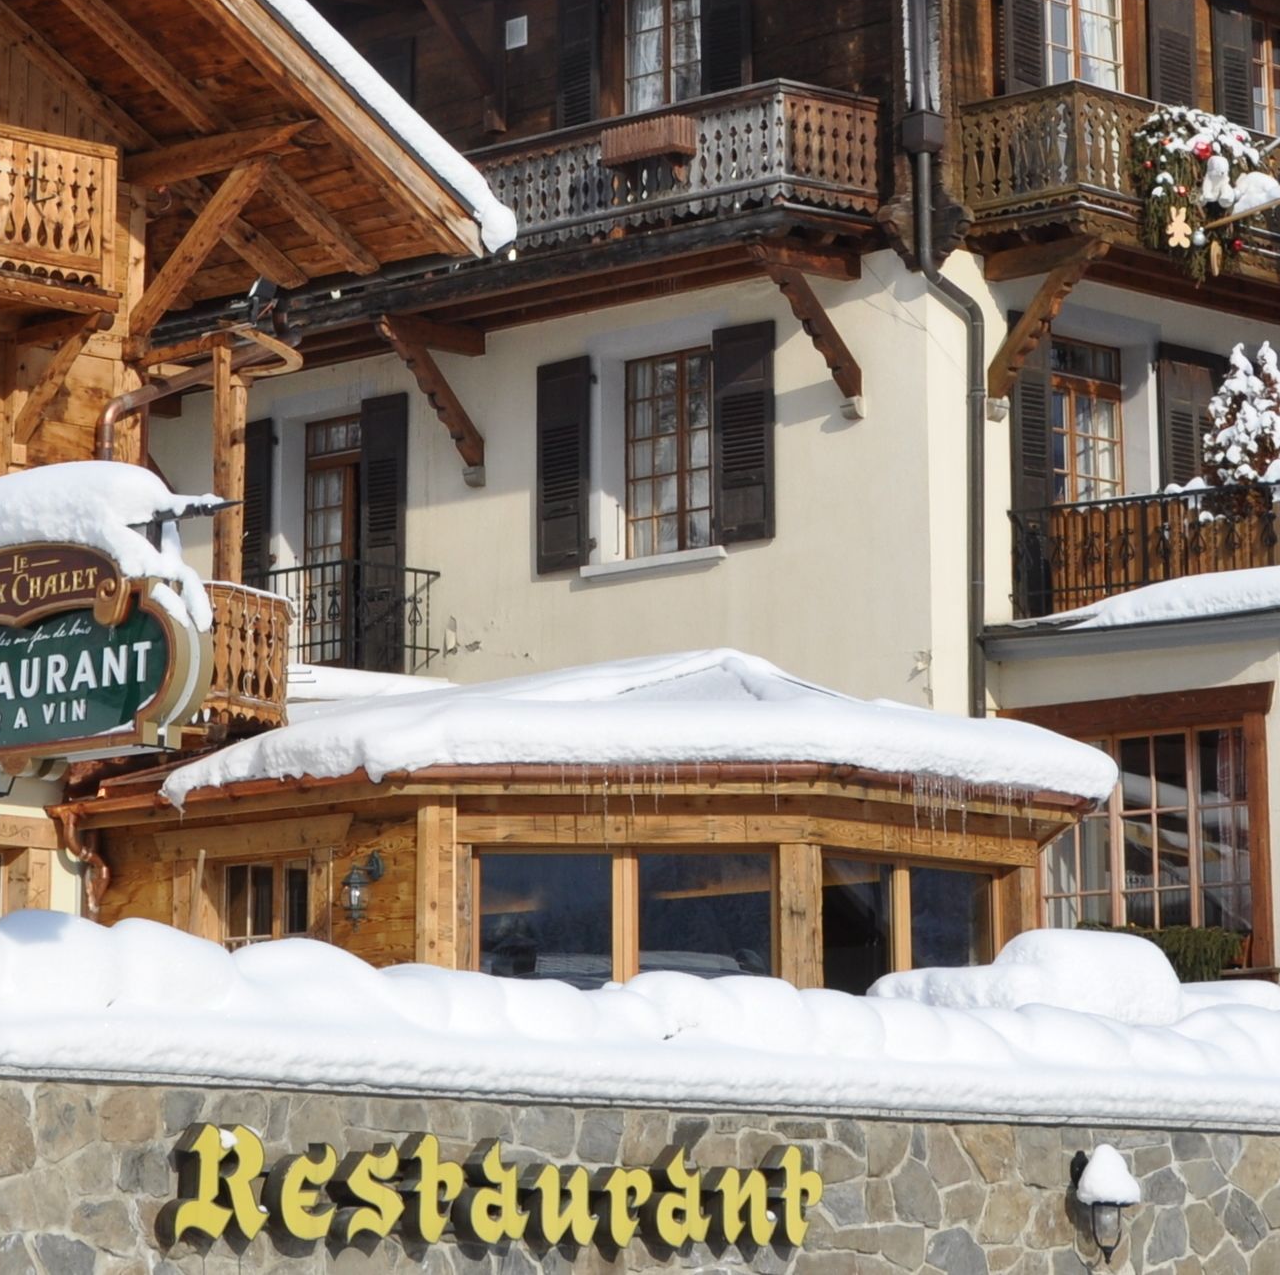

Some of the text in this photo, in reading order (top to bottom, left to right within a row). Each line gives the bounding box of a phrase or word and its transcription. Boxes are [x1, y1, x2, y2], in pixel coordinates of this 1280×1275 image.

[11, 567, 98, 606] CHALET
[52, 622, 67, 638] de
[68, 618, 92, 636] bois
[13, 706, 29, 729] A
[42, 698, 86, 724] VIN
[170, 1123, 823, 1249] Restaurant
